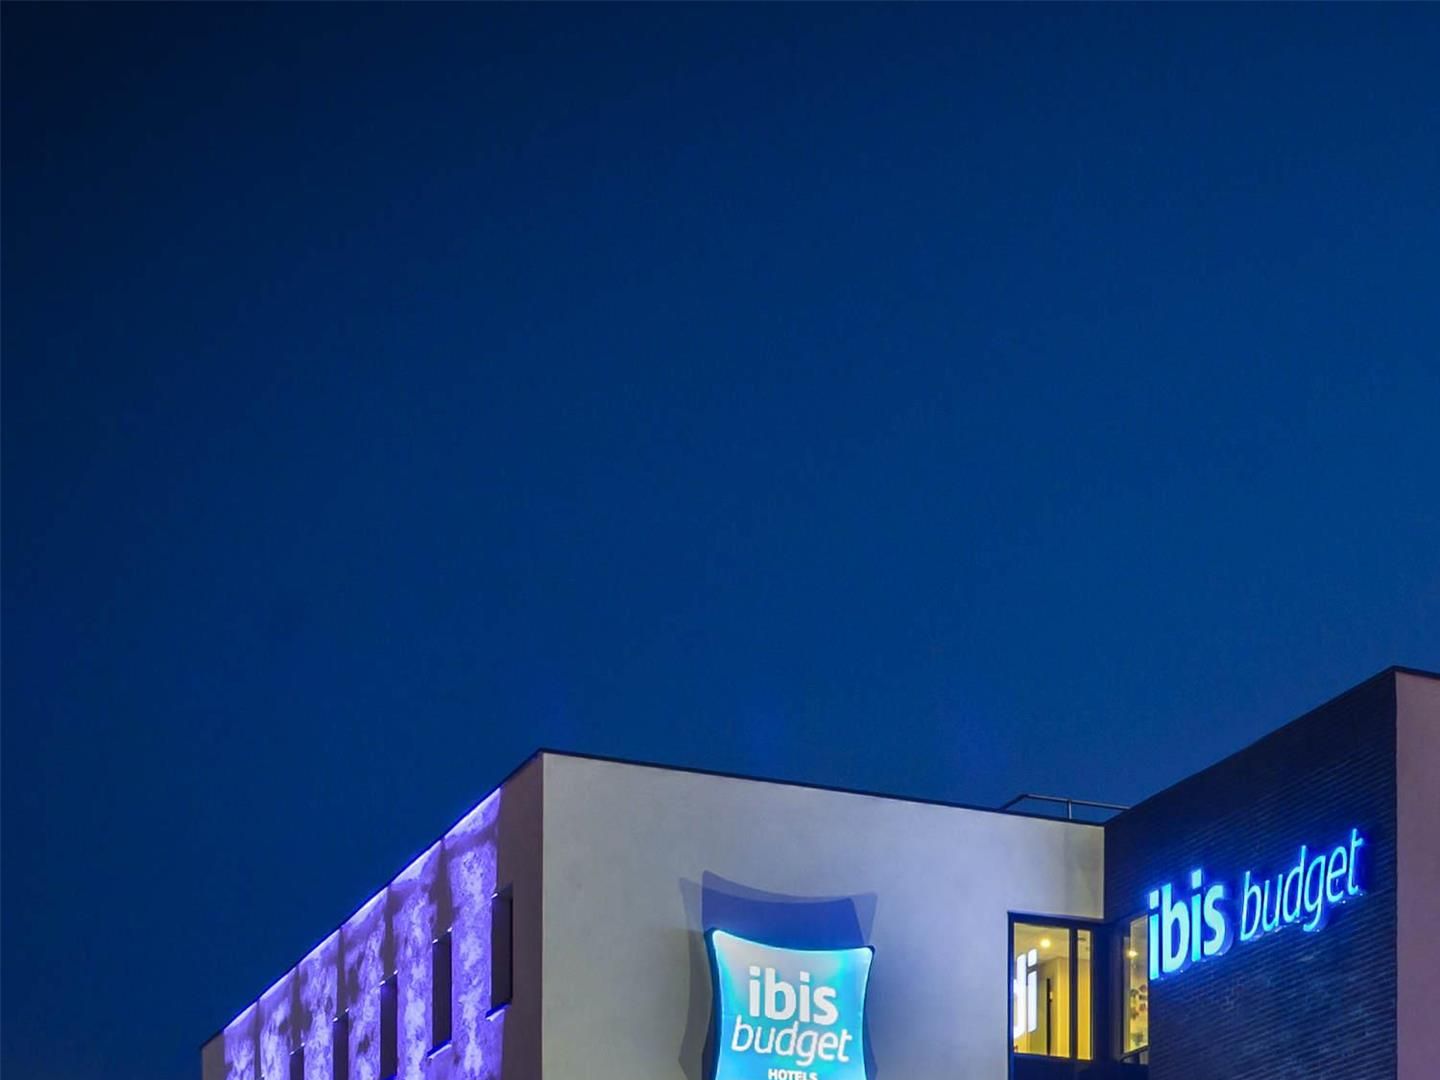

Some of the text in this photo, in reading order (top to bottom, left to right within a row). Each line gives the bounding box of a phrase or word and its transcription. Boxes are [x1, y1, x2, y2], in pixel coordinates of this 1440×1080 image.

[1149, 828, 1364, 980] ibis budget
[749, 965, 839, 1026] ibis
[731, 1014, 852, 1066] budget
